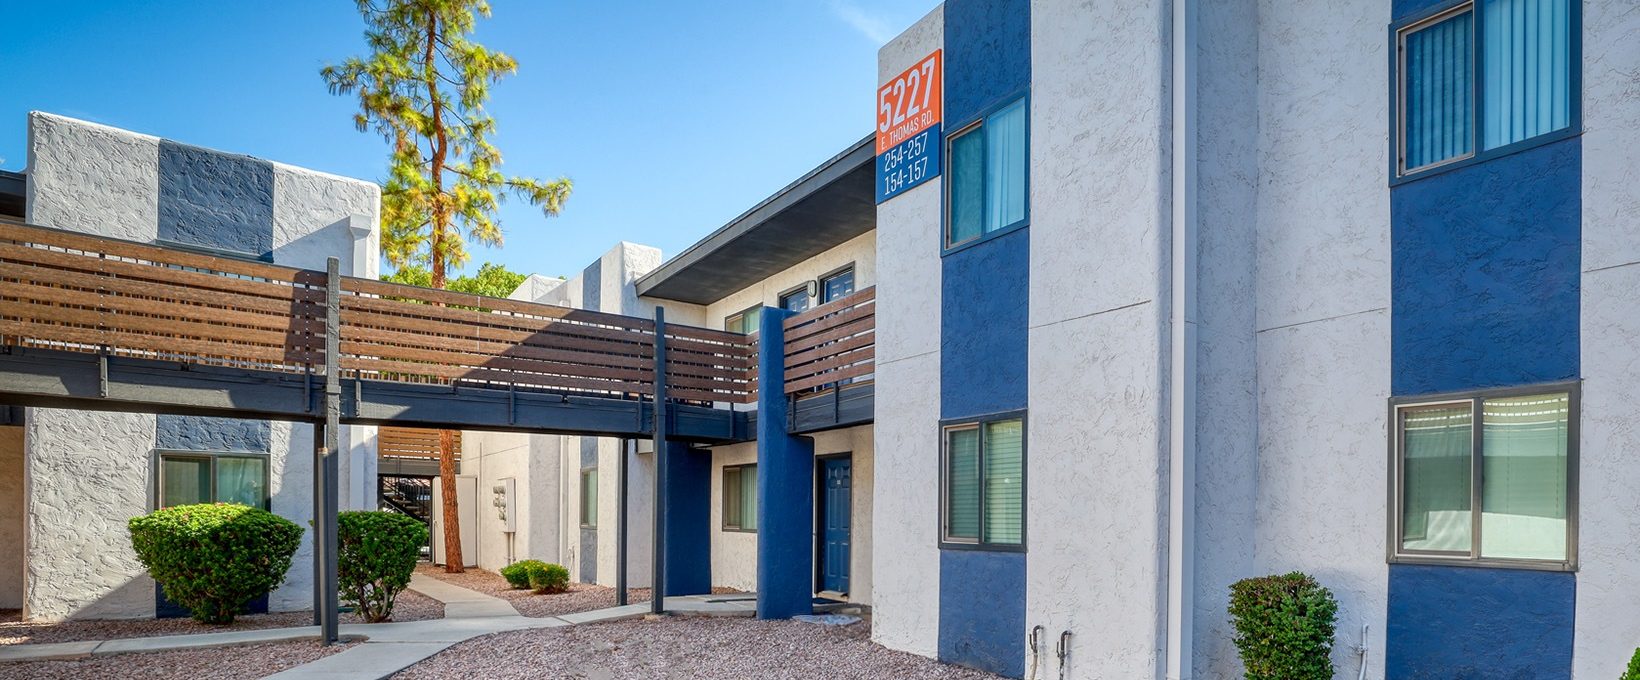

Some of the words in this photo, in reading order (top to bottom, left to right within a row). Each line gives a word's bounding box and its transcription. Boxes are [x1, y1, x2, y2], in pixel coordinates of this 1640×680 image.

[879, 56, 935, 133] 5227
[881, 136, 887, 150] E.
[889, 118, 919, 145] THOMAS
[921, 110, 934, 126] RD.
[884, 132, 928, 172] 254-257
[884, 157, 928, 195] 154-157
